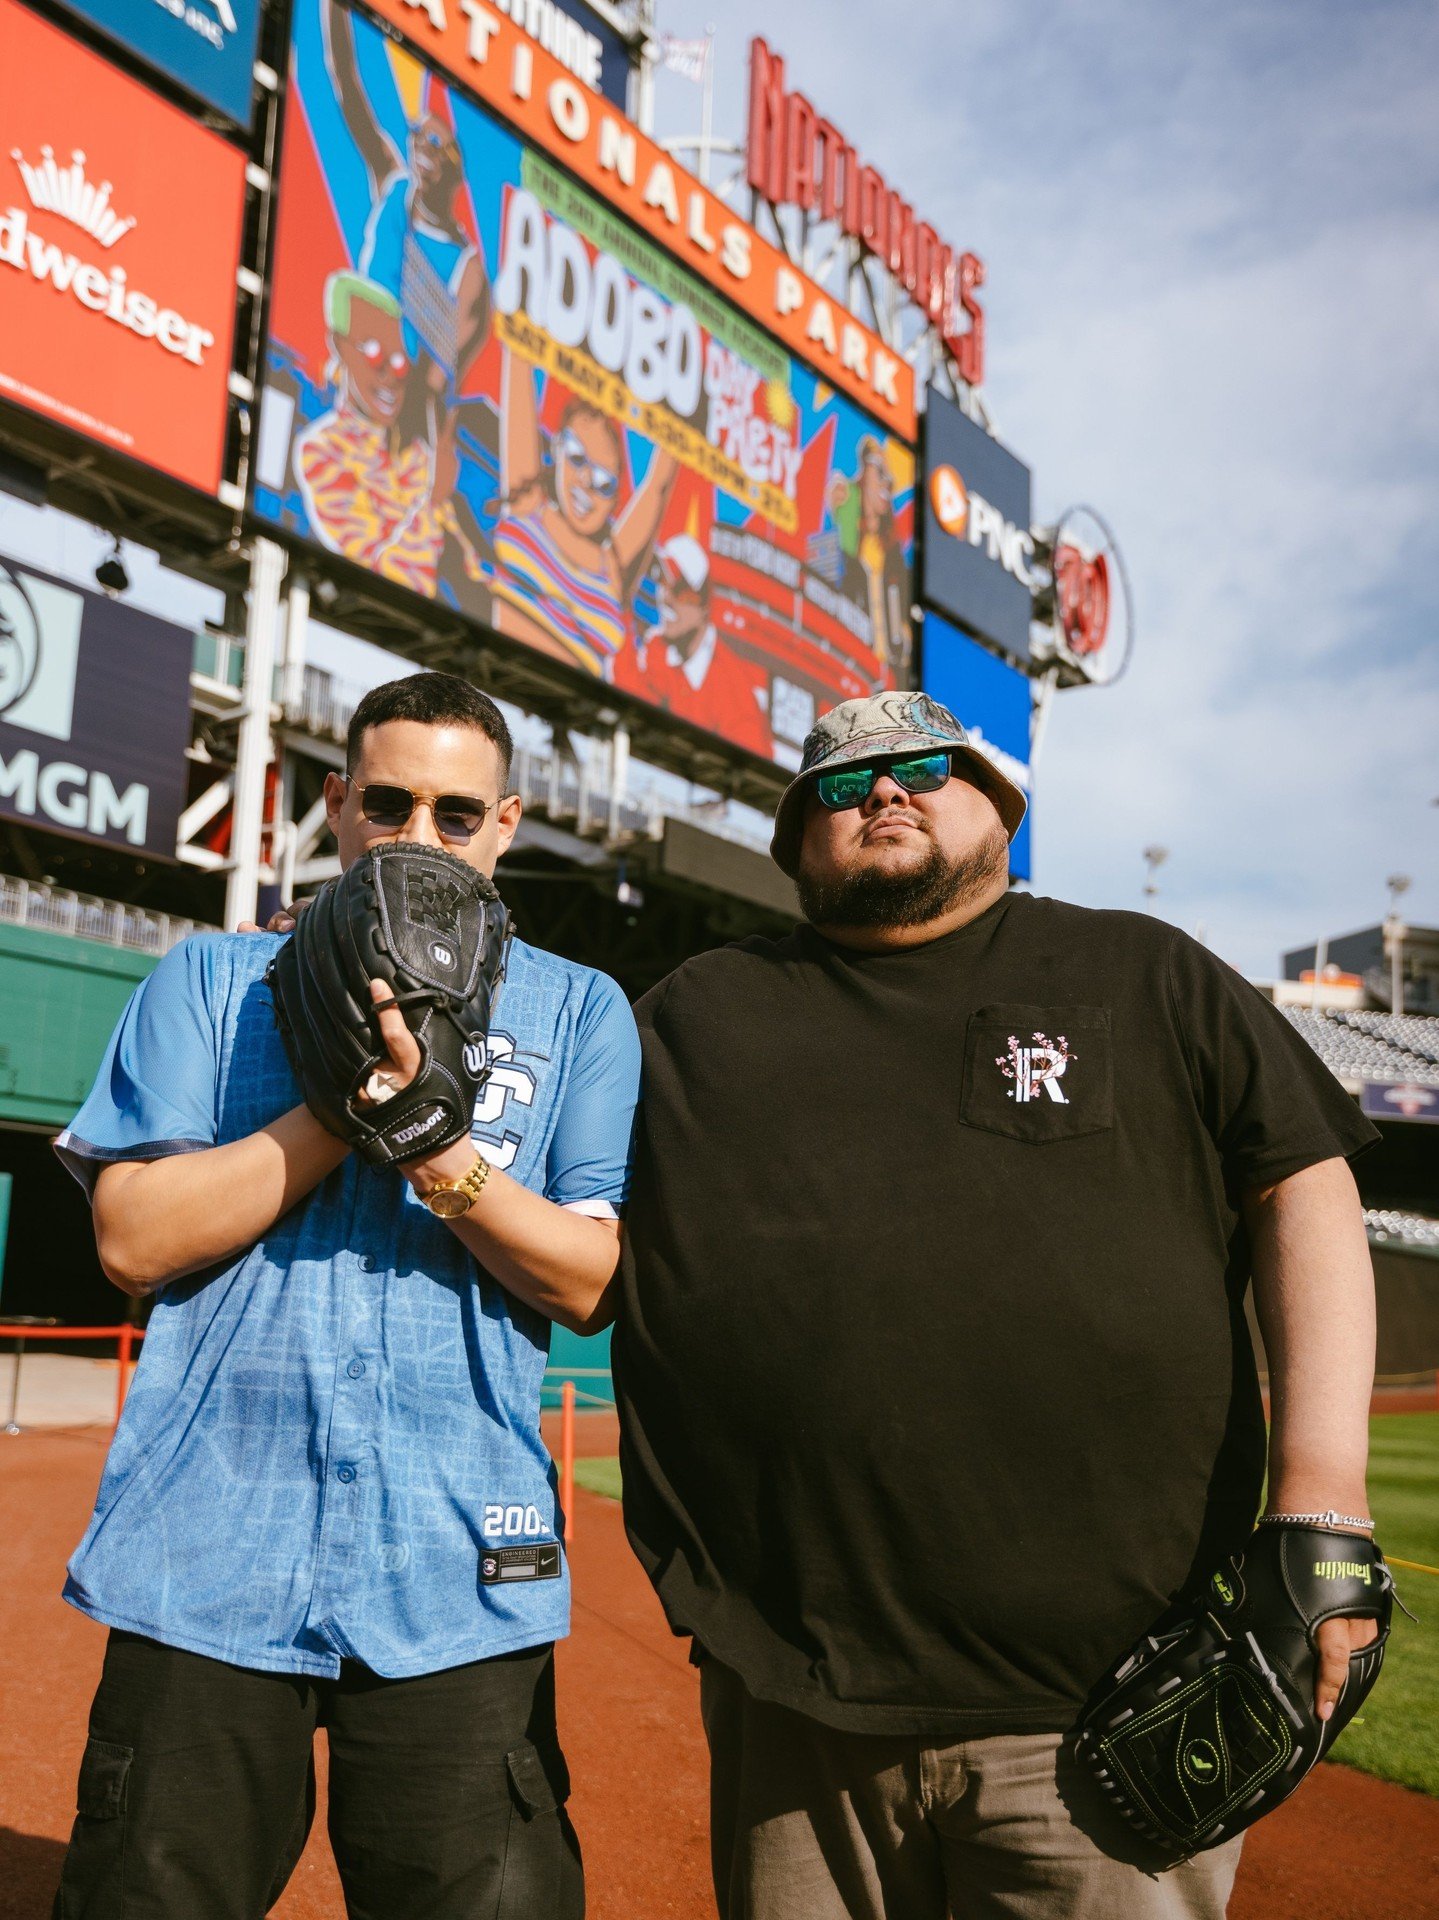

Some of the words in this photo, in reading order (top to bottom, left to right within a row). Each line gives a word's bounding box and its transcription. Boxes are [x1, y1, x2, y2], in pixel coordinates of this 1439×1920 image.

[495, 188, 702, 418] ADOBO
[775, 265, 904, 406] PARK
[503, 315, 546, 358] SAT
[555, 347, 606, 397] MAY
[703, 340, 765, 414] DAY
[966, 488, 1036, 590] PNC
[391, 1105, 447, 1144] Wilson
